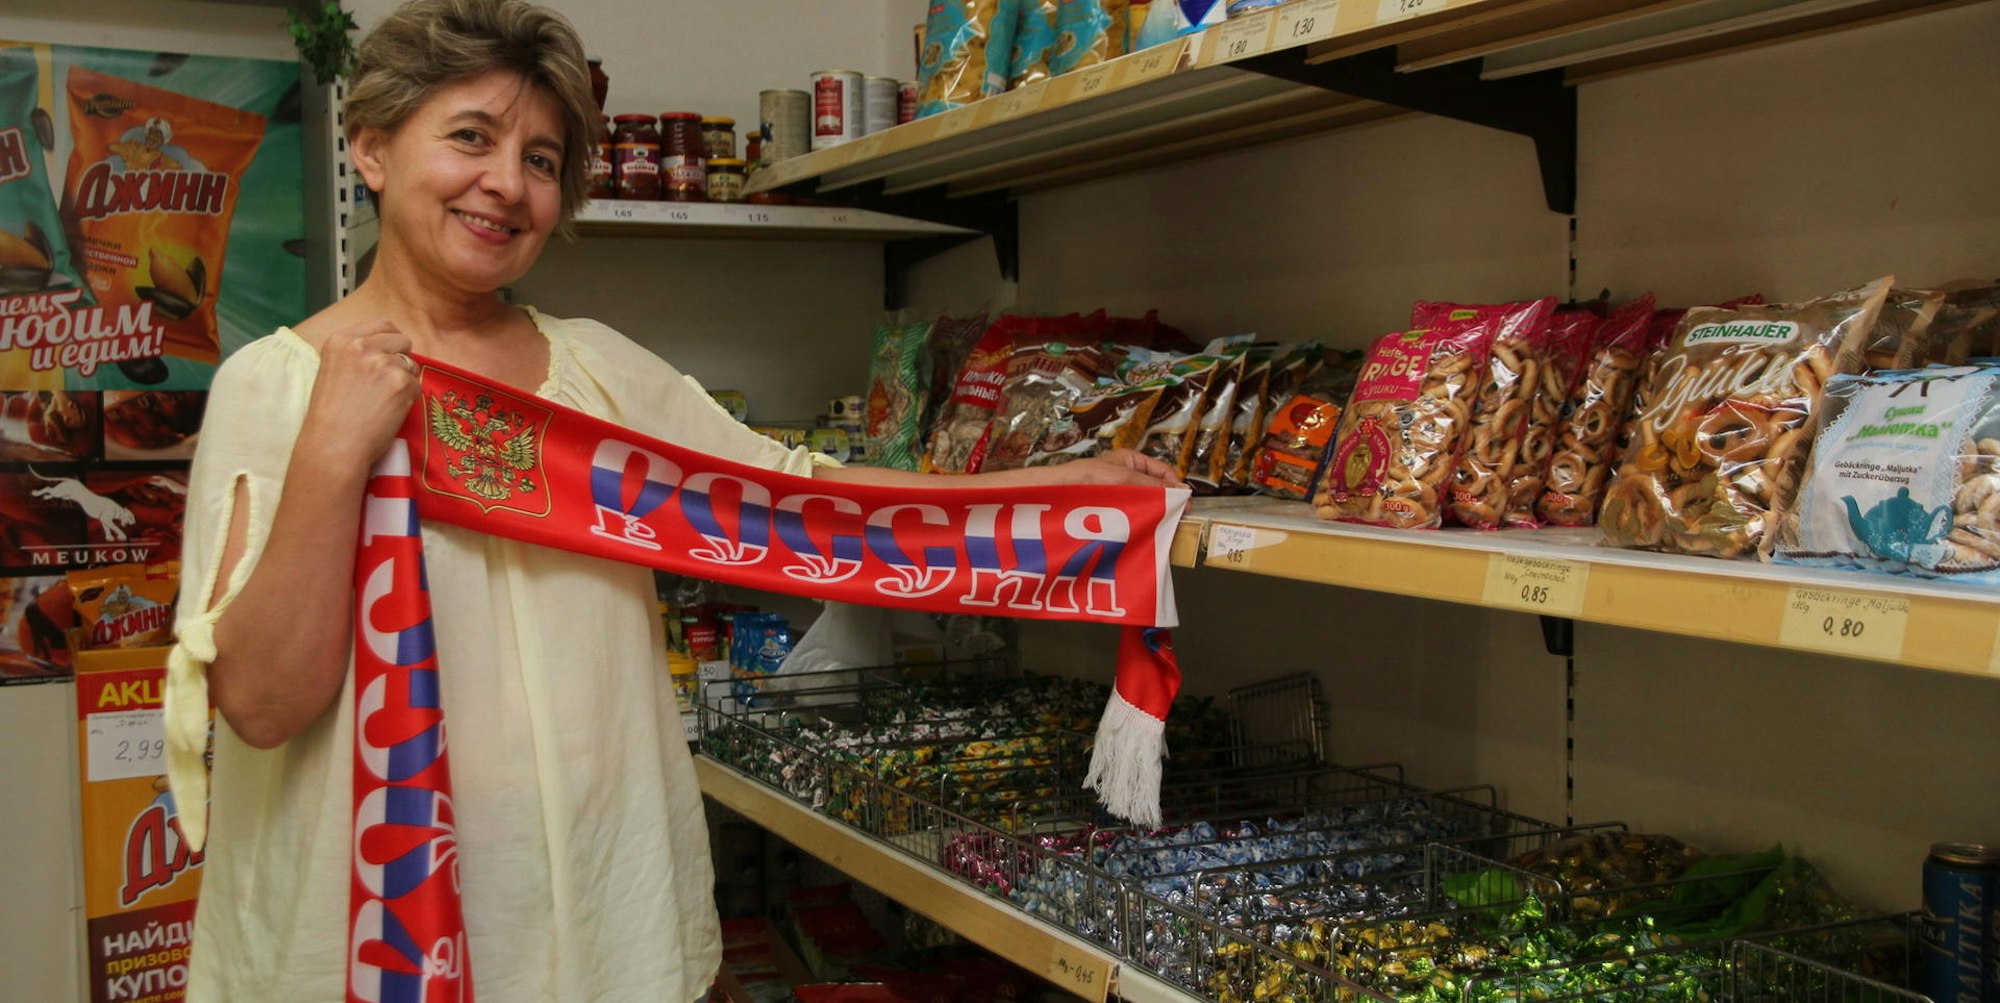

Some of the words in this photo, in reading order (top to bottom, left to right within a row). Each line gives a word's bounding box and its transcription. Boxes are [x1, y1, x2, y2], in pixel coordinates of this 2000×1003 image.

[1293, 17, 1315, 39] 1,30
[1228, 40, 1247, 57] 1,80
[1688, 324, 1792, 342] STEINHAUER
[32, 348, 54, 370] и
[61, 327, 164, 375] едим!
[1834, 460, 1881, 473] Gebäckringe
[1839, 471, 1851, 479] mit
[1852, 471, 1910, 485] Zuckerüberzug
[590, 437, 1132, 617] РОССИЯ
[32, 549, 150, 565] MEUKOW
[1521, 584, 1549, 603] 0,85
[115, 740, 164, 762] 2,99
